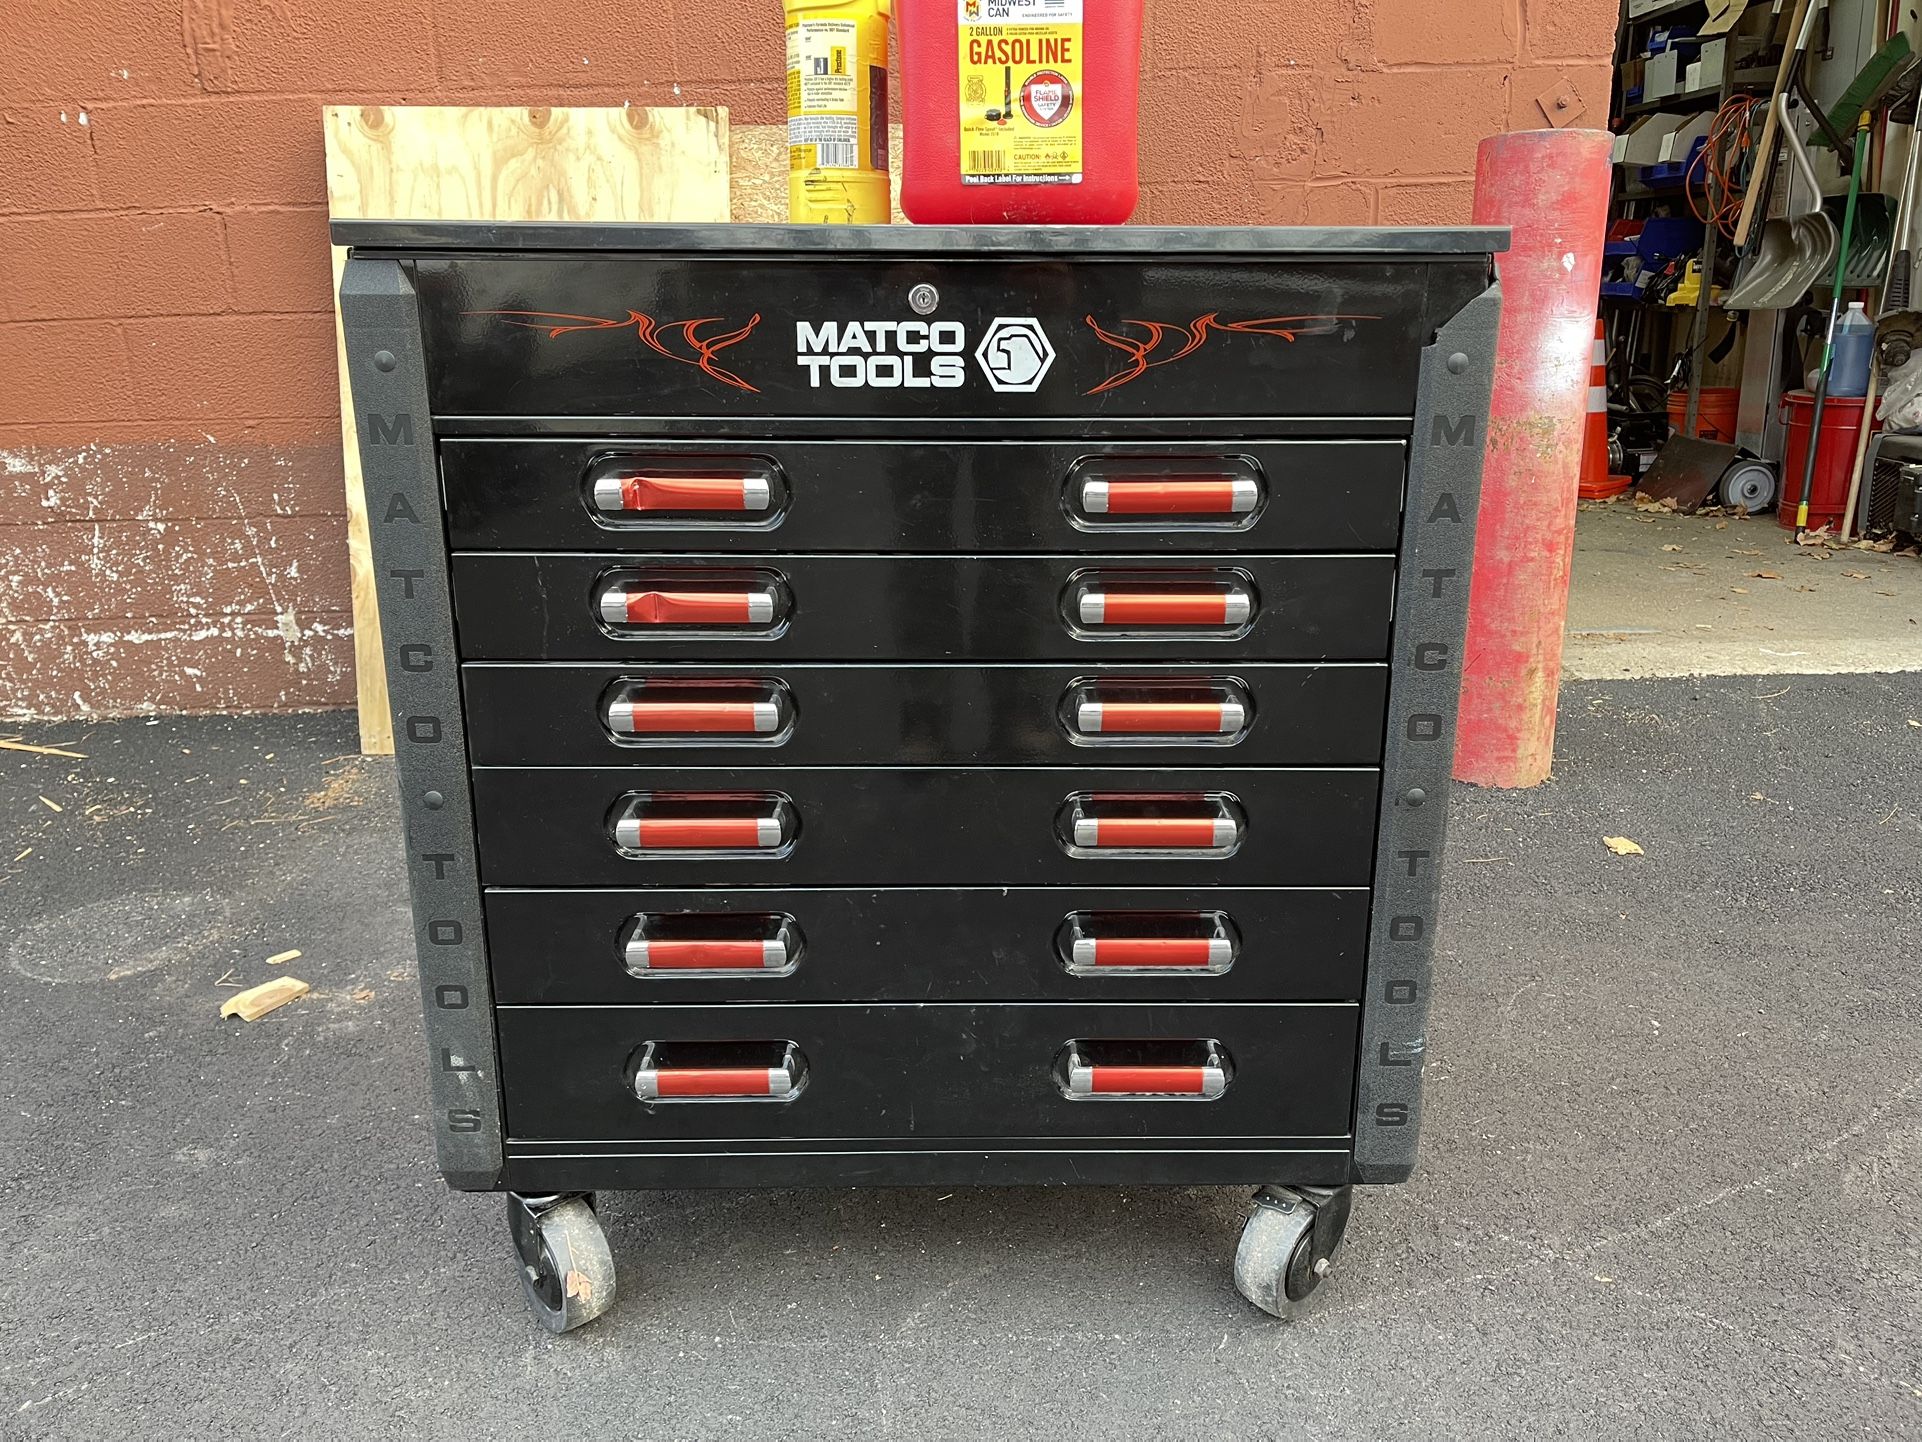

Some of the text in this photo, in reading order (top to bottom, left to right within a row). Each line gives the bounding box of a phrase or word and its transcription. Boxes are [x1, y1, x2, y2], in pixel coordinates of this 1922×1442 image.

[988, 7, 1010, 18] CAN
[969, 26, 1002, 36] 2 GALLON
[969, 38, 1072, 64] GASOLINE
[995, 174, 1012, 182] Label
[1023, 174, 1058, 182] Instructions
[796, 320, 965, 353] MATCO
[797, 355, 965, 388] TOOLS
[367, 413, 442, 744] MATCO
[1406, 414, 1477, 742] MATCO
[422, 853, 482, 1133] TOOLS
[1375, 851, 1430, 1127] TOOLS
